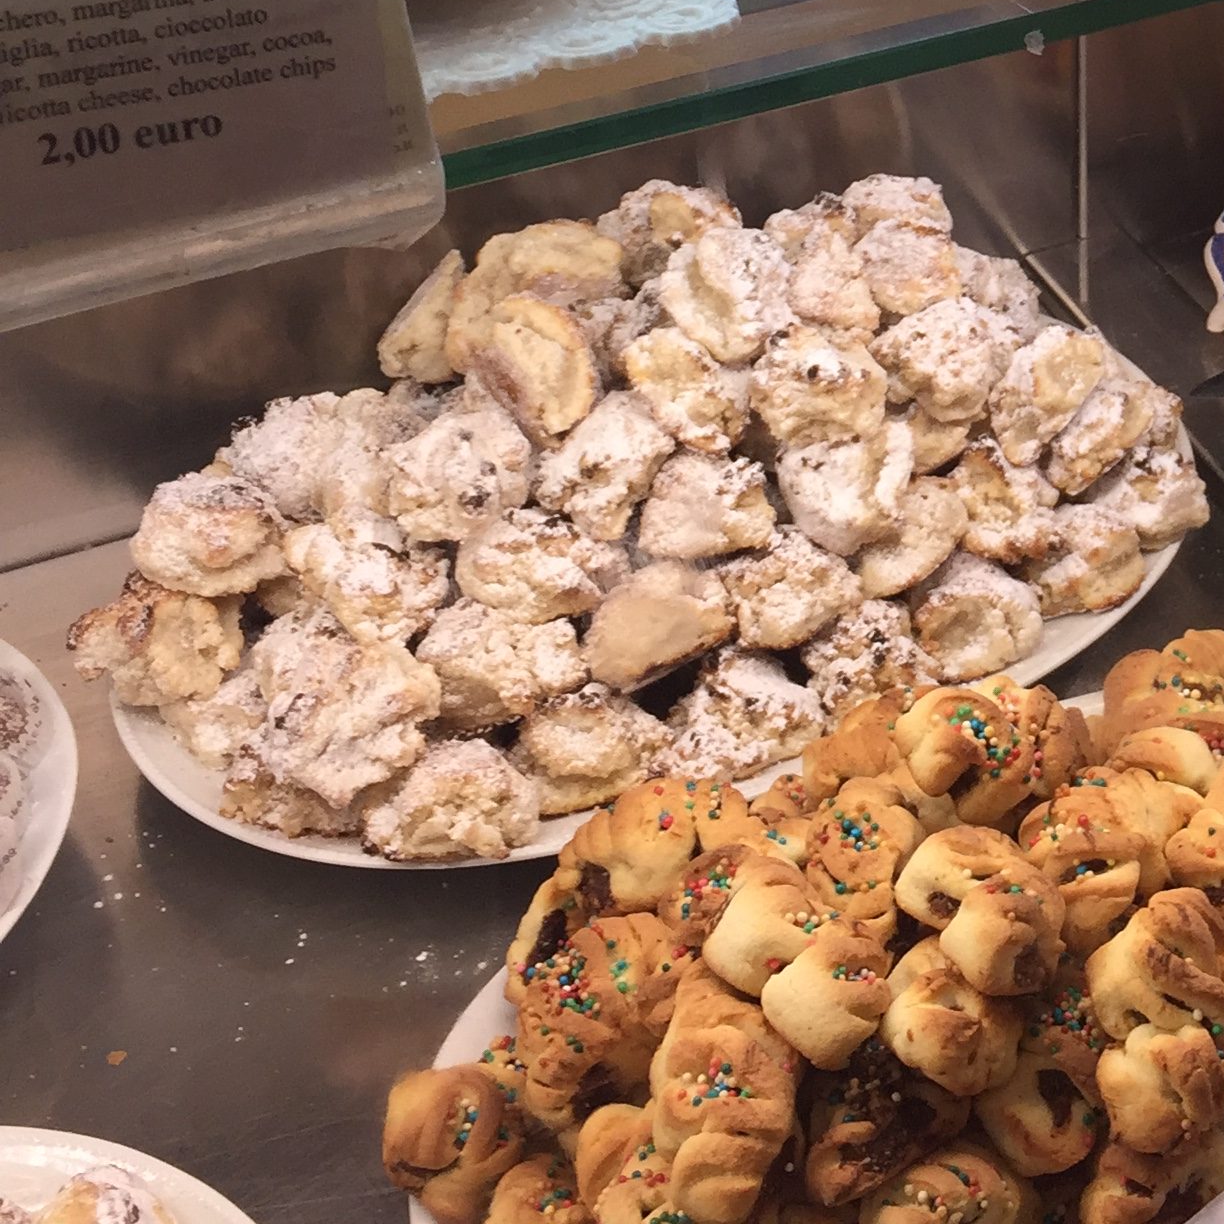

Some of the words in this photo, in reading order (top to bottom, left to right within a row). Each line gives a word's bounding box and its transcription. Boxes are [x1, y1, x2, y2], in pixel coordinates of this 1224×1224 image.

[66, 30, 148, 53] ricotta,
[153, 8, 268, 39] cioccolato
[38, 55, 161, 86] margarine,
[167, 40, 257, 67] vinegar,
[262, 30, 333, 52] cocoa,
[77, 86, 163, 113] cheese,
[167, 67, 274, 98] chocolate
[279, 55, 337, 79] chips
[36, 122, 121, 167] 2,00
[134, 114, 224, 149] euro
